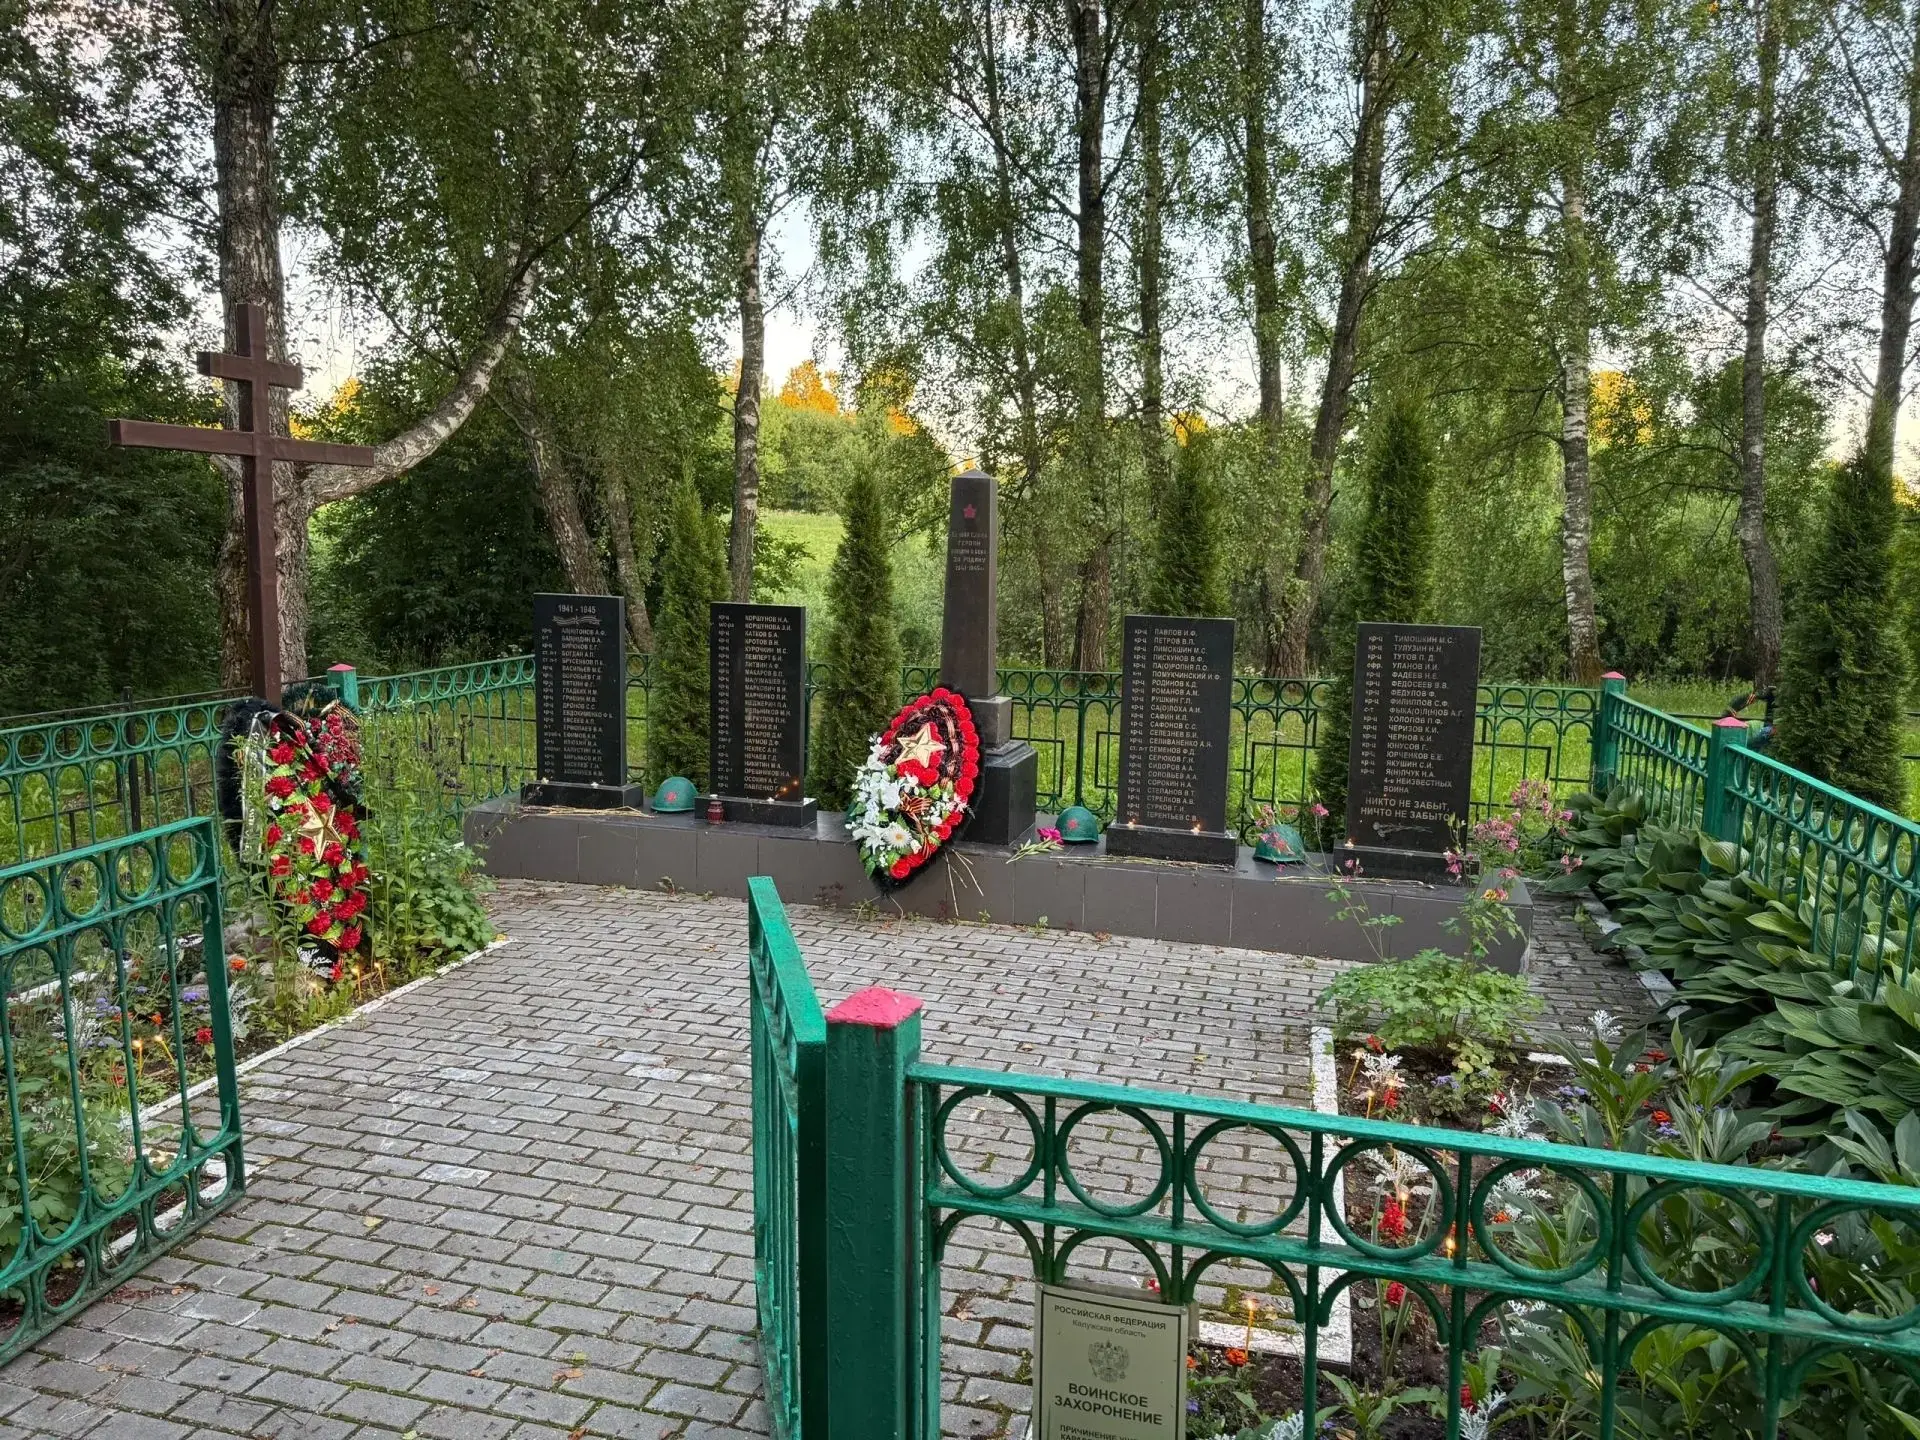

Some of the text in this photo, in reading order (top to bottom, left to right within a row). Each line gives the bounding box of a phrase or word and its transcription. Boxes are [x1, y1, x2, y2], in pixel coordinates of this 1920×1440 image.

[1150, 738, 1198, 747] СЕЛИВАНЕНКО
[1396, 778, 1452, 787] НЕИЗВЕСТНЫХ
[1361, 808, 1392, 816] НИЧТО
[1366, 798, 1395, 806] НИКТО
[1414, 801, 1450, 811] ЗАБЫТ,
[1055, 1305, 1166, 1330] РОССИЙСКАЯ ФЕДЕРАЦИЯ
[1073, 1320, 1146, 1338] Калужская область
[1069, 1383, 1148, 1408] ВОИНСКОЕ
[1055, 1396, 1162, 1425] ЗАХОРОНЕНИЕ
[1060, 1425, 1117, 1440] ПРИЧИНЕНИЕ
